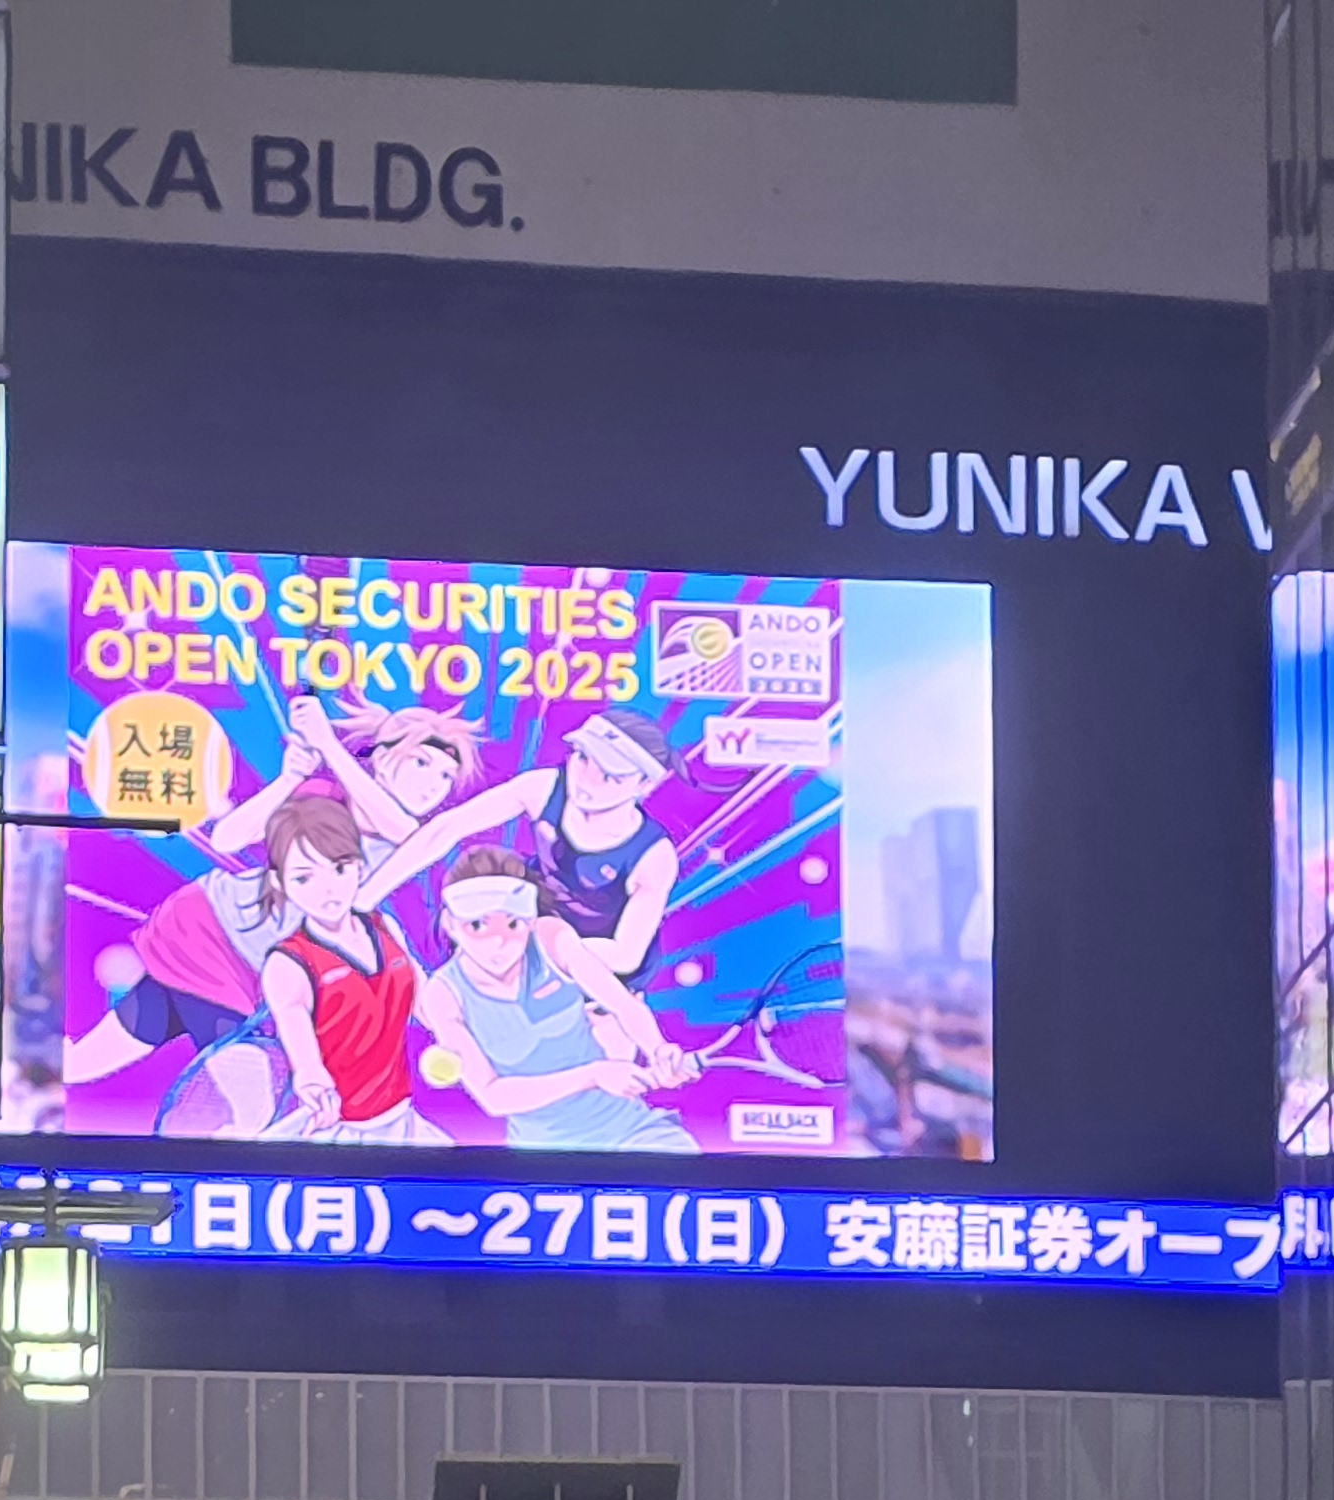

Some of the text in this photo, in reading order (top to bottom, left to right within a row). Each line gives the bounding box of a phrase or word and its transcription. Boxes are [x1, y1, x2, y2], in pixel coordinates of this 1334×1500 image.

[251, 134, 525, 232] BLDG.
[799, 446, 1208, 547] YUNIKA
[84, 567, 637, 638] ANDO SECURITIES
[749, 614, 821, 634] ANDO
[85, 628, 640, 702] OPEN TOKYO 2025
[749, 652, 822, 673] OPEN
[118, 723, 194, 760] 入場
[118, 768, 196, 804] 無料
